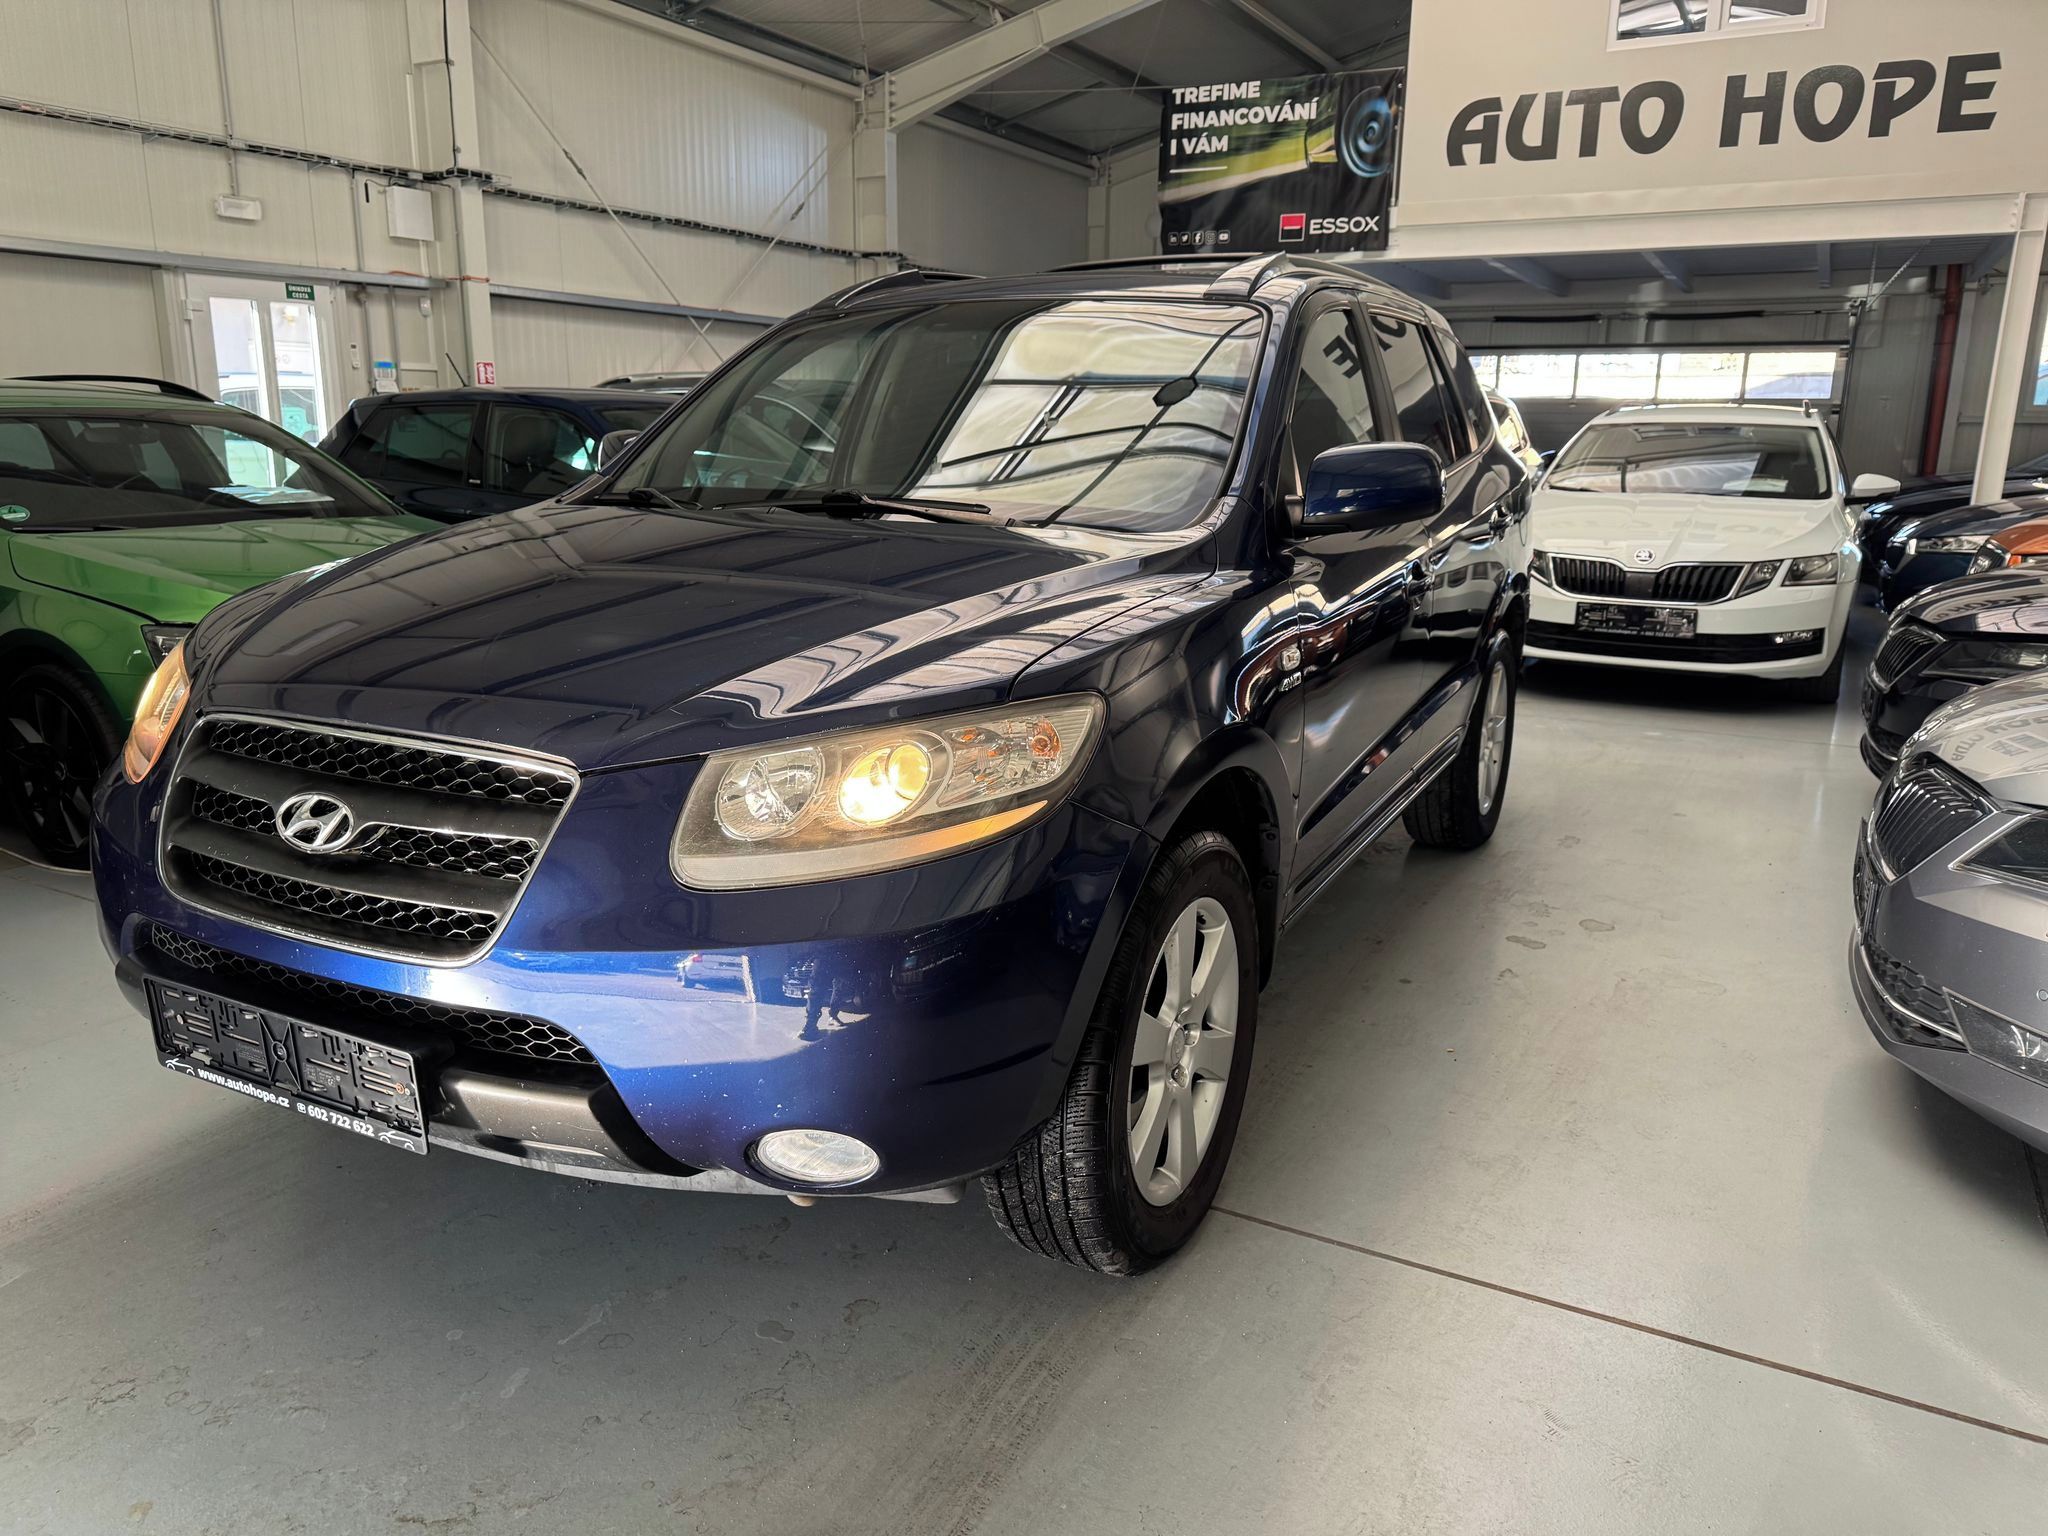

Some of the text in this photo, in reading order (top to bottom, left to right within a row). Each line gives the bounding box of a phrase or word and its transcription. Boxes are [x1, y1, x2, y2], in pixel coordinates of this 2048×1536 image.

[1171, 80, 1261, 105] TREFIME
[1171, 97, 1320, 131] FINANCOVÁNÍ
[1446, 51, 2002, 167] AUTO HOPE
[1169, 133, 1229, 156] I VÁM
[1308, 215, 1380, 235] ESSOX
[197, 1068, 290, 1109] www.autohope.cz
[307, 1104, 329, 1122] 602
[329, 1111, 352, 1129] 722
[353, 1119, 375, 1137] 622
